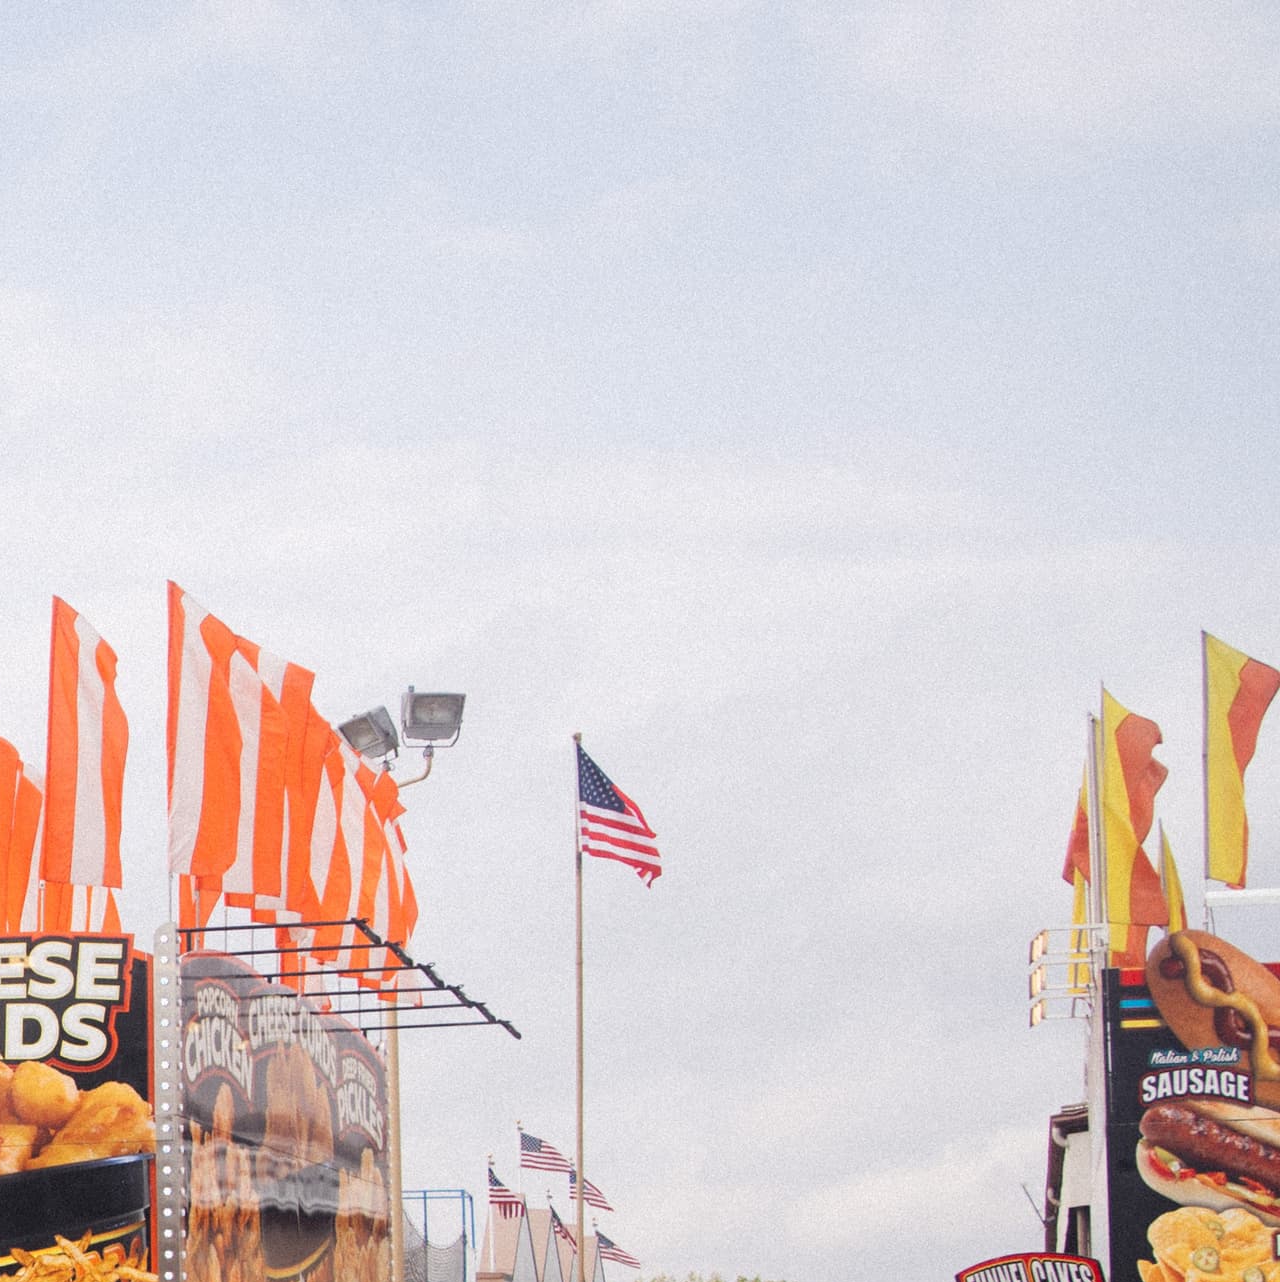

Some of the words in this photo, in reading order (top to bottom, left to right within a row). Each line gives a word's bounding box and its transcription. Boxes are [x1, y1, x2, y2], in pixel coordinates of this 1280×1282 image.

[197, 987, 239, 1027] POPCORN
[185, 1016, 254, 1100] CHICKEN
[248, 995, 298, 1050] CHEESE
[299, 1005, 337, 1088] CURDS
[1150, 1050, 1188, 1065] Italian
[1191, 1050, 1199, 1062] &
[1203, 1047, 1239, 1063] Polish
[1142, 1068, 1250, 1103] SAUSAGE
[337, 1080, 384, 1150] PICKLES
